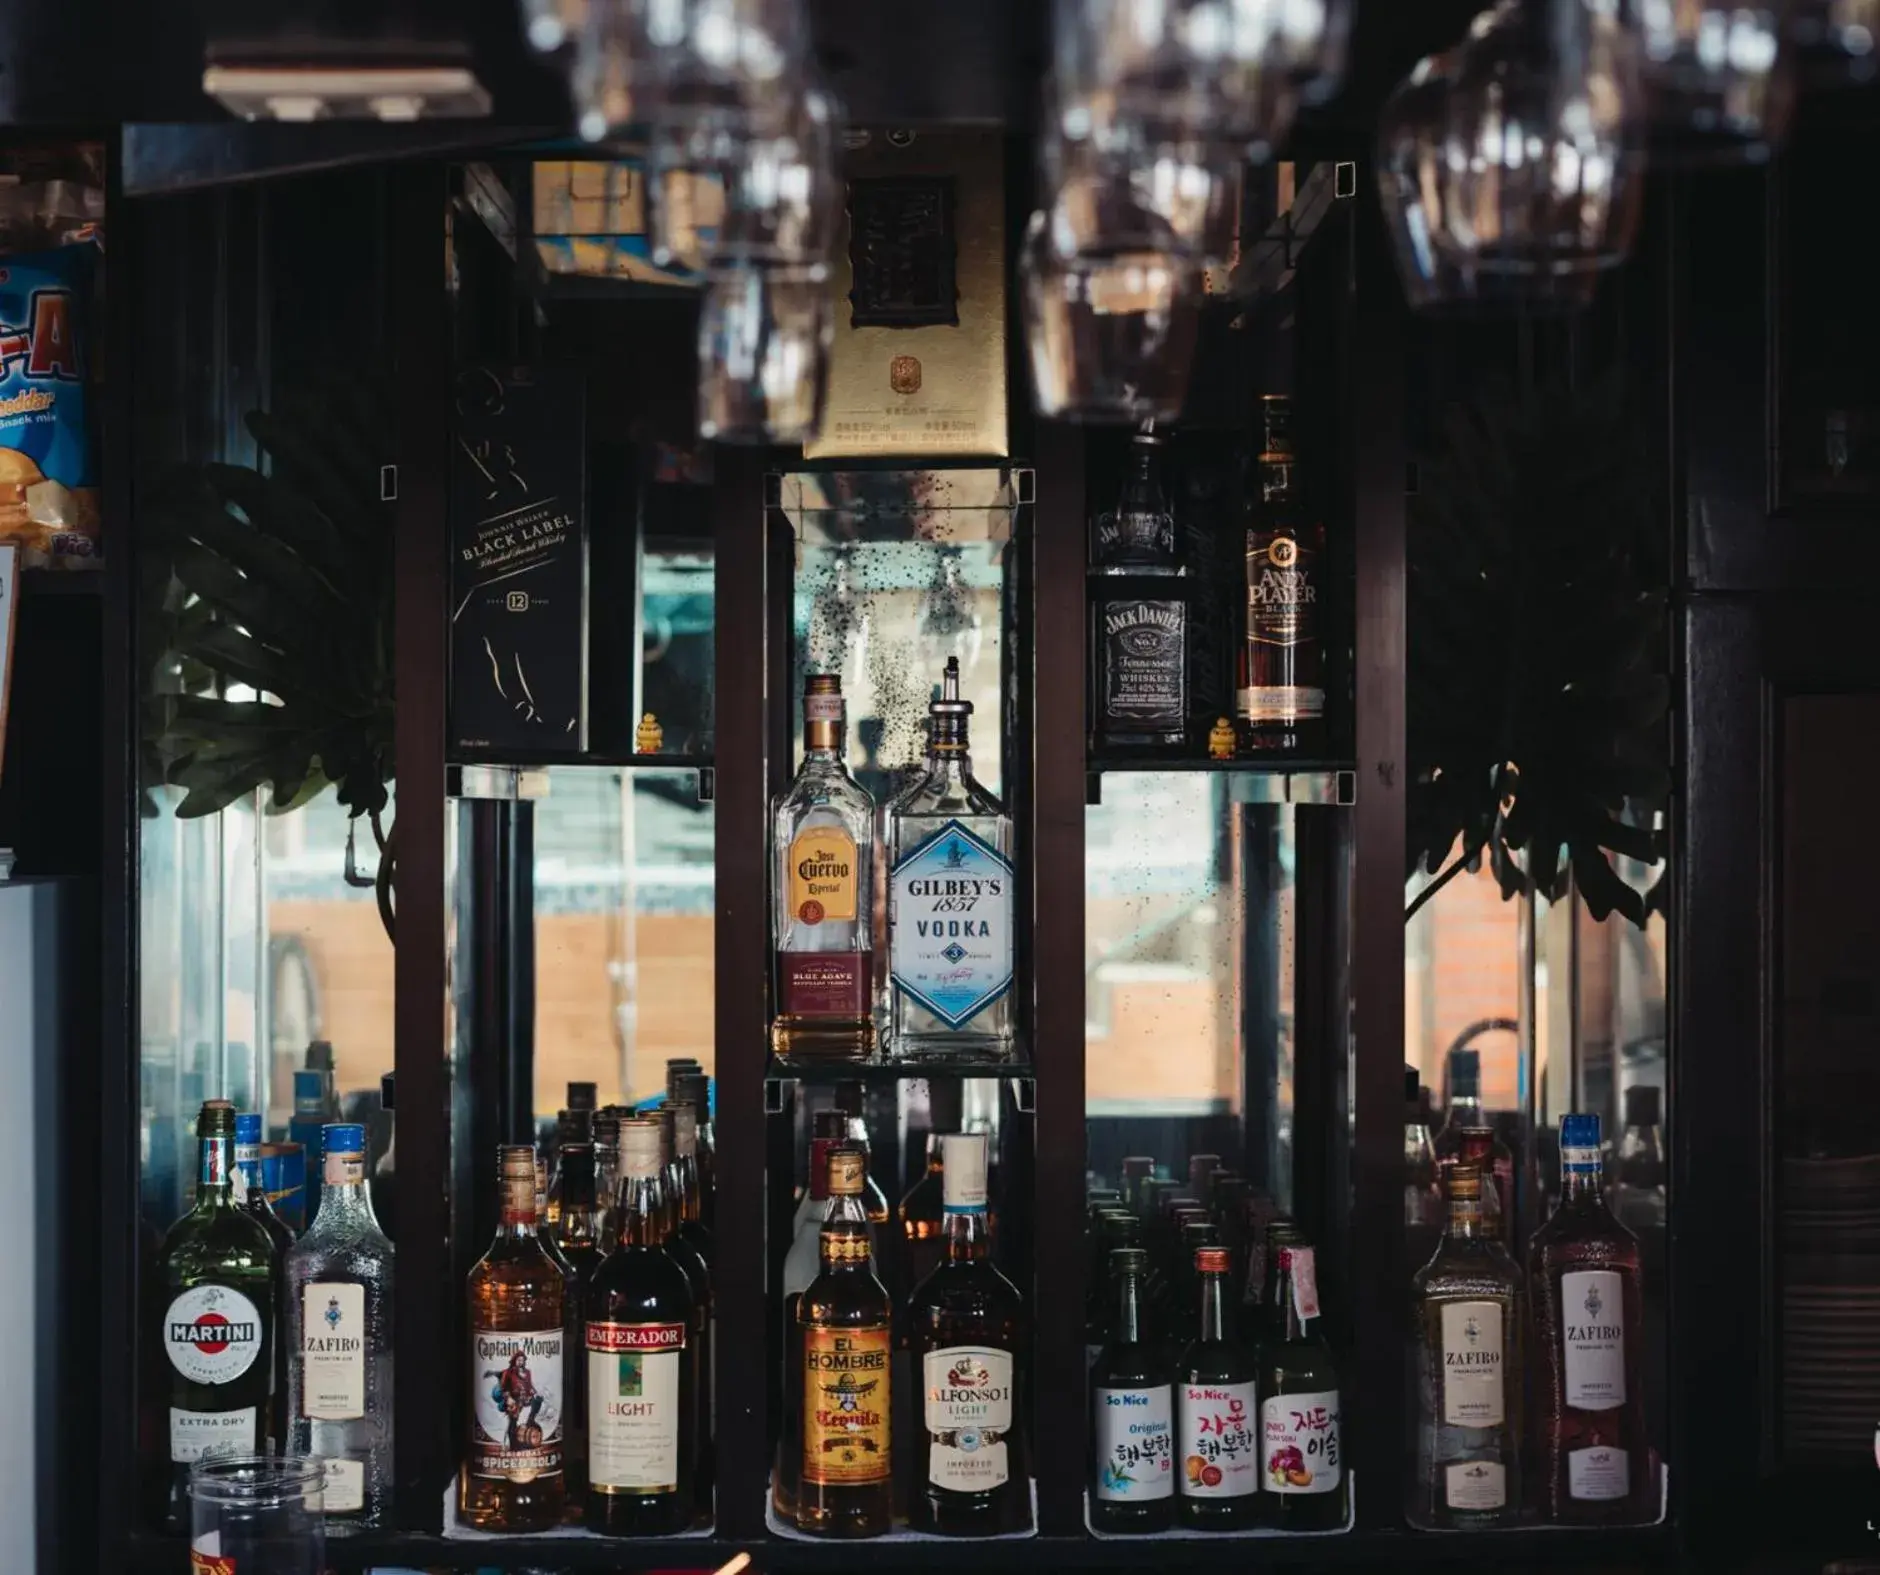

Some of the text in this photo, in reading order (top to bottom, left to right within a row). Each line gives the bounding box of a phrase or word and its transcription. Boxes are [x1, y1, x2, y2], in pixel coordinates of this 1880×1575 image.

[462, 514, 575, 561] BLACK LABEL
[1260, 568, 1309, 588] ANDY
[511, 595, 526, 608] 12
[1248, 585, 1317, 605] PLAYER
[1105, 609, 1138, 635] JACK
[1119, 673, 1172, 683] WHISKEY
[798, 858, 849, 881] Cuervo
[908, 879, 1001, 897] GILBEY'S
[931, 896, 980, 912] 1857
[917, 919, 990, 938] VODKA
[173, 1324, 253, 1342] MARTINI
[588, 1328, 679, 1345] EMPERADOR
[1567, 1325, 1621, 1341] ZAFIRO
[307, 1337, 360, 1352] ZAFIRO
[477, 1335, 561, 1361] Captain Morgan
[834, 1337, 855, 1351] EL
[808, 1352, 885, 1369] HOMBRE
[1446, 1351, 1500, 1365] ZAFIRO
[928, 1388, 1001, 1403] ALFONSO
[1106, 1394, 1149, 1406] So Nice
[1188, 1389, 1230, 1400] So Nice
[607, 1402, 656, 1417] LIGHT
[948, 1404, 988, 1415] LIGHT
[179, 1416, 247, 1427] EXTRA DRY
[816, 1410, 881, 1428] Tequila
[1129, 1421, 1168, 1434] Original
